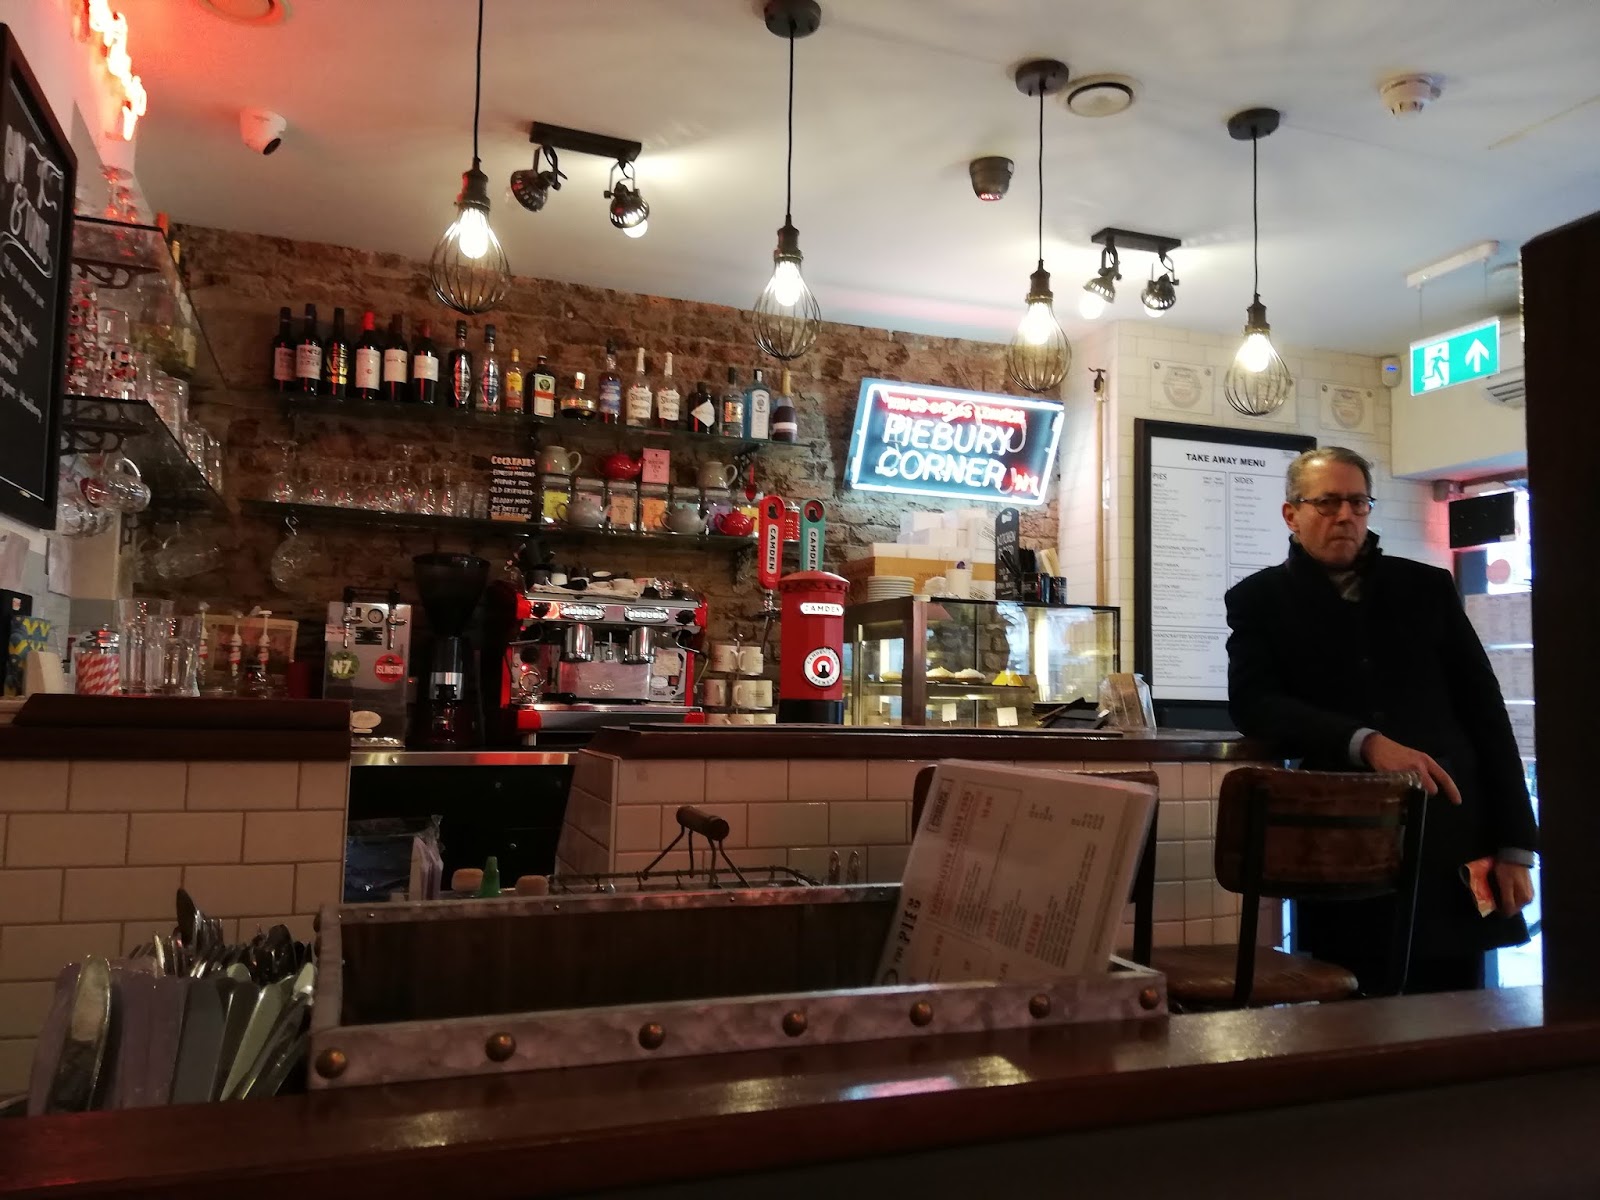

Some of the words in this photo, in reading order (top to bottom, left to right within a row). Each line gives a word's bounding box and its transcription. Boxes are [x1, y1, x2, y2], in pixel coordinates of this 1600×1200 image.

[882, 412, 1015, 456] PIEBURY
[491, 455, 536, 467] COCKTAILS
[1186, 453, 1210, 463] TAKE
[1212, 455, 1238, 465] AWAY
[1240, 458, 1266, 468] MENU
[875, 448, 1007, 489] CORNER
[1234, 476, 1255, 485] SIDES
[804, 604, 841, 613] CAMDEN
[333, 660, 352, 674] N7
[376, 665, 404, 675] ISLINGTON
